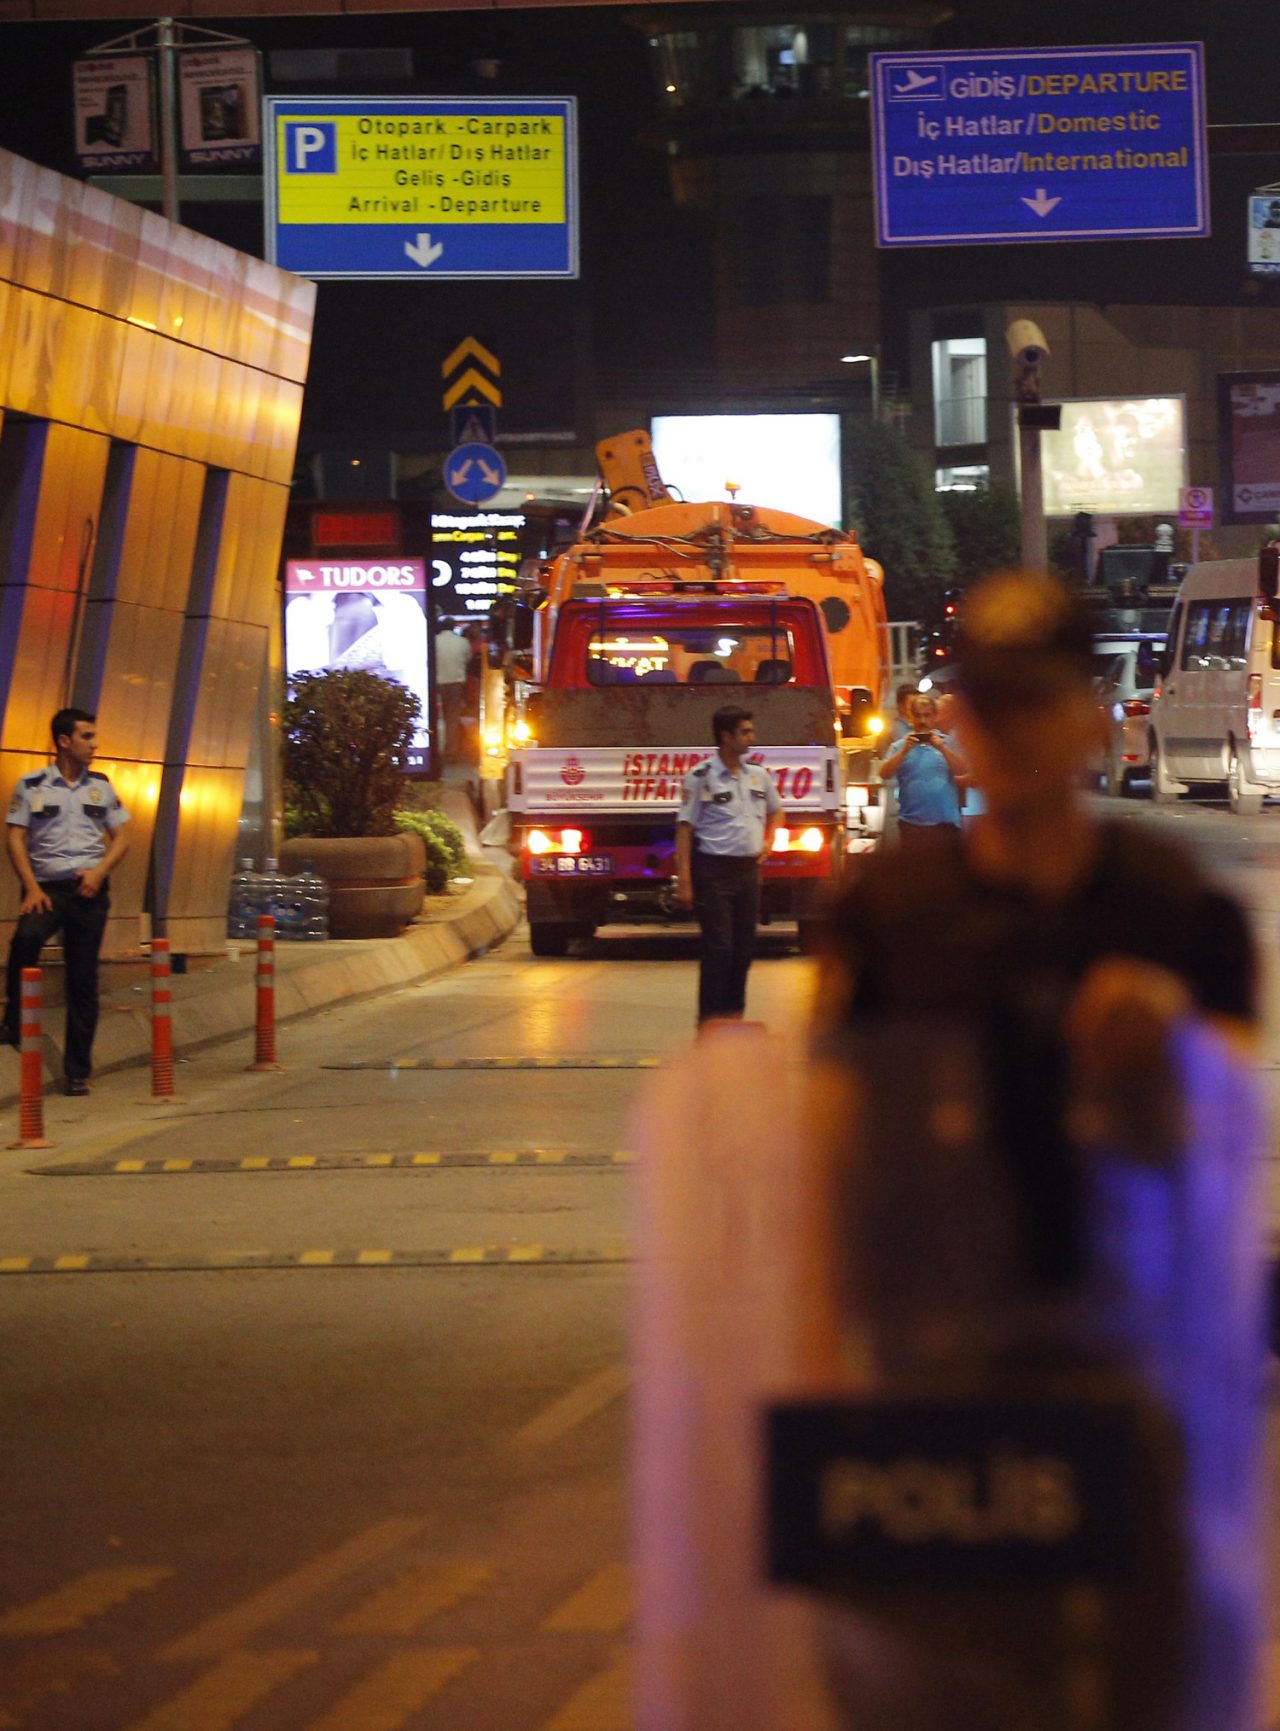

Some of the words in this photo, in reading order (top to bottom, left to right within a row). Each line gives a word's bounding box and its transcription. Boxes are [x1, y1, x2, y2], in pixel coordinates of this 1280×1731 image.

[358, 117, 446, 140] Otopark
[917, 111, 940, 140] İç
[294, 127, 326, 169] P
[352, 141, 368, 161] İç
[893, 156, 934, 178] Dış
[348, 196, 418, 212] Arrival
[320, 566, 415, 587] TUDORS
